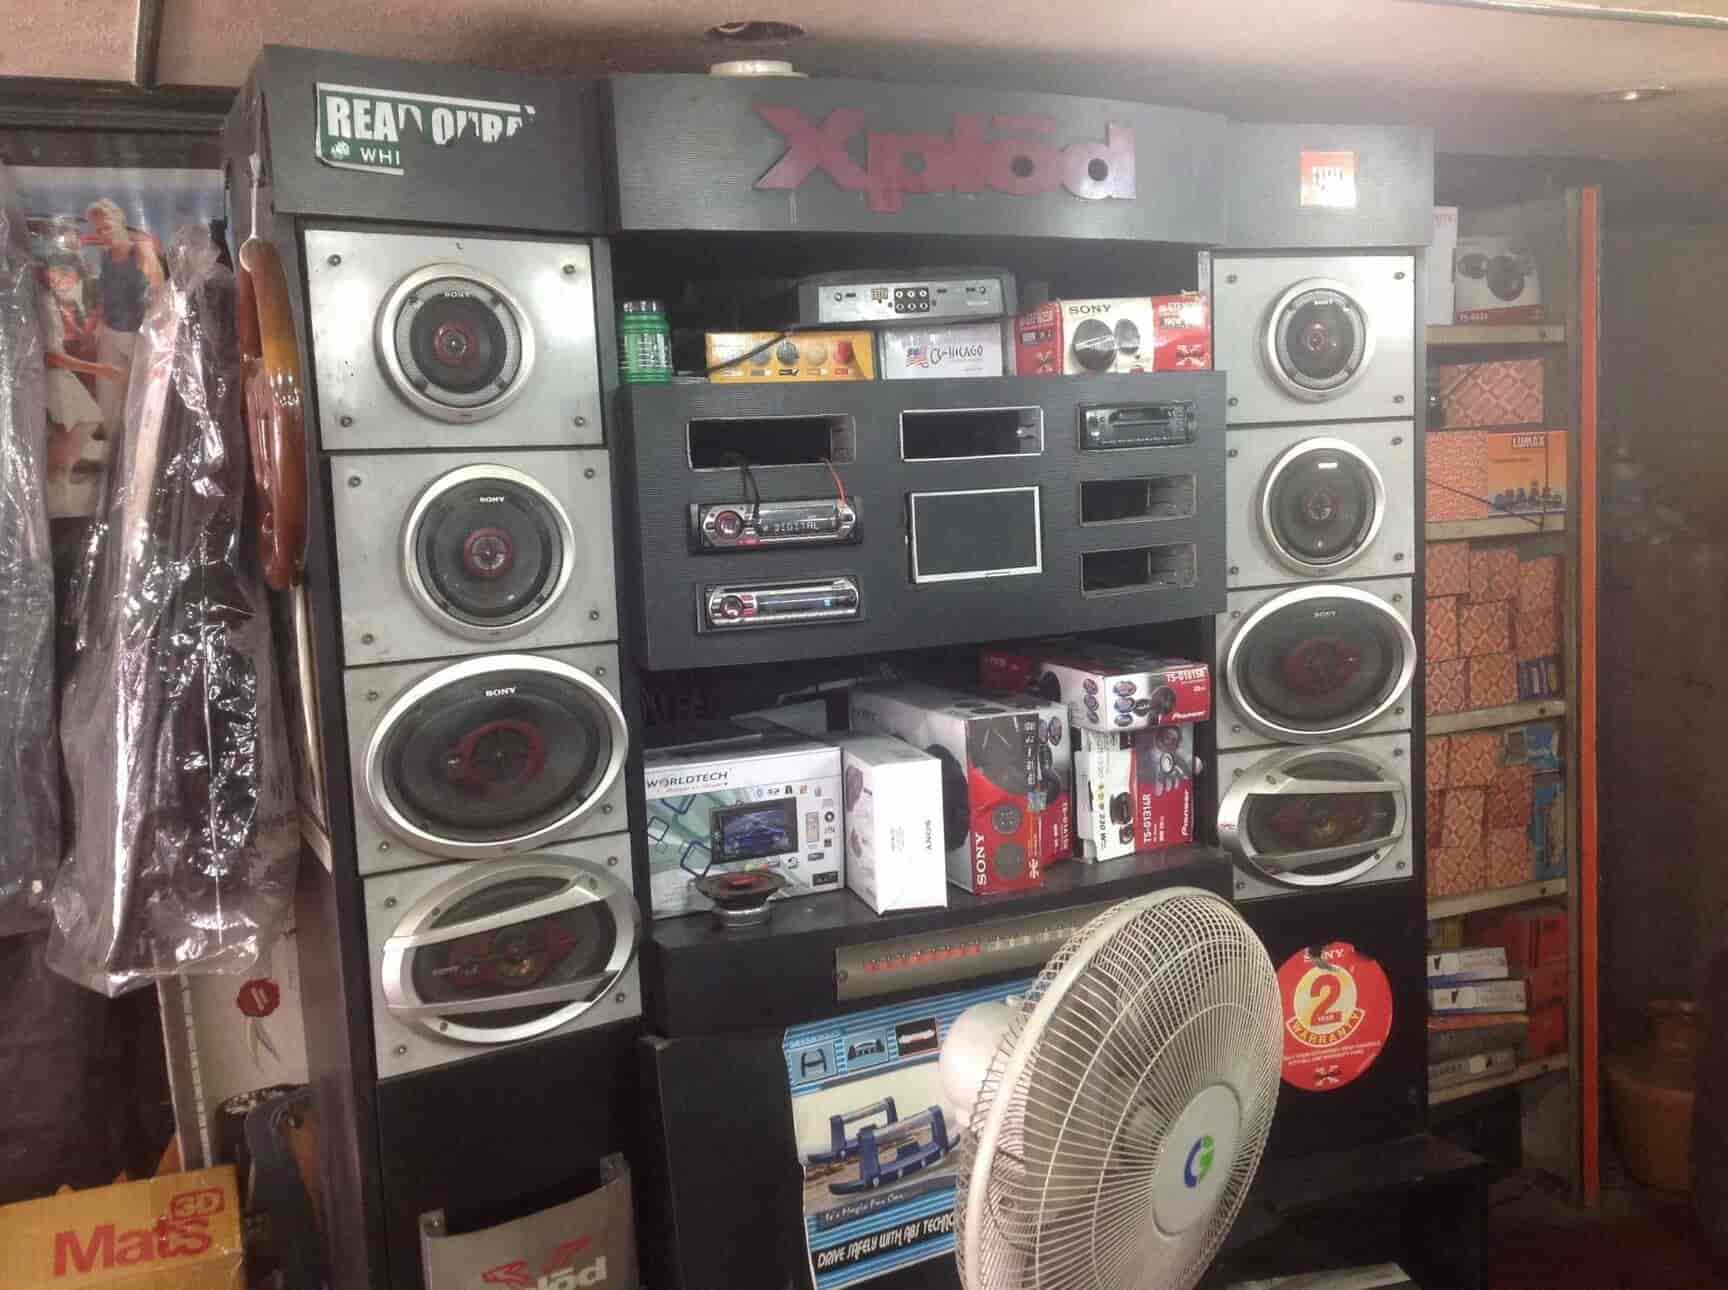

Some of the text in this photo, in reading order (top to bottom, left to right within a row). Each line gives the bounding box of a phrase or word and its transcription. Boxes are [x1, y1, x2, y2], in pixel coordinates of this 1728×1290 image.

[1069, 304, 1111, 314] SONY
[647, 771, 728, 789] WORLDTECH
[975, 832, 987, 886] SONY
[1311, 974, 1341, 1026] 2
[817, 1246, 847, 1268] DRIVE
[879, 1227, 903, 1250] WITH
